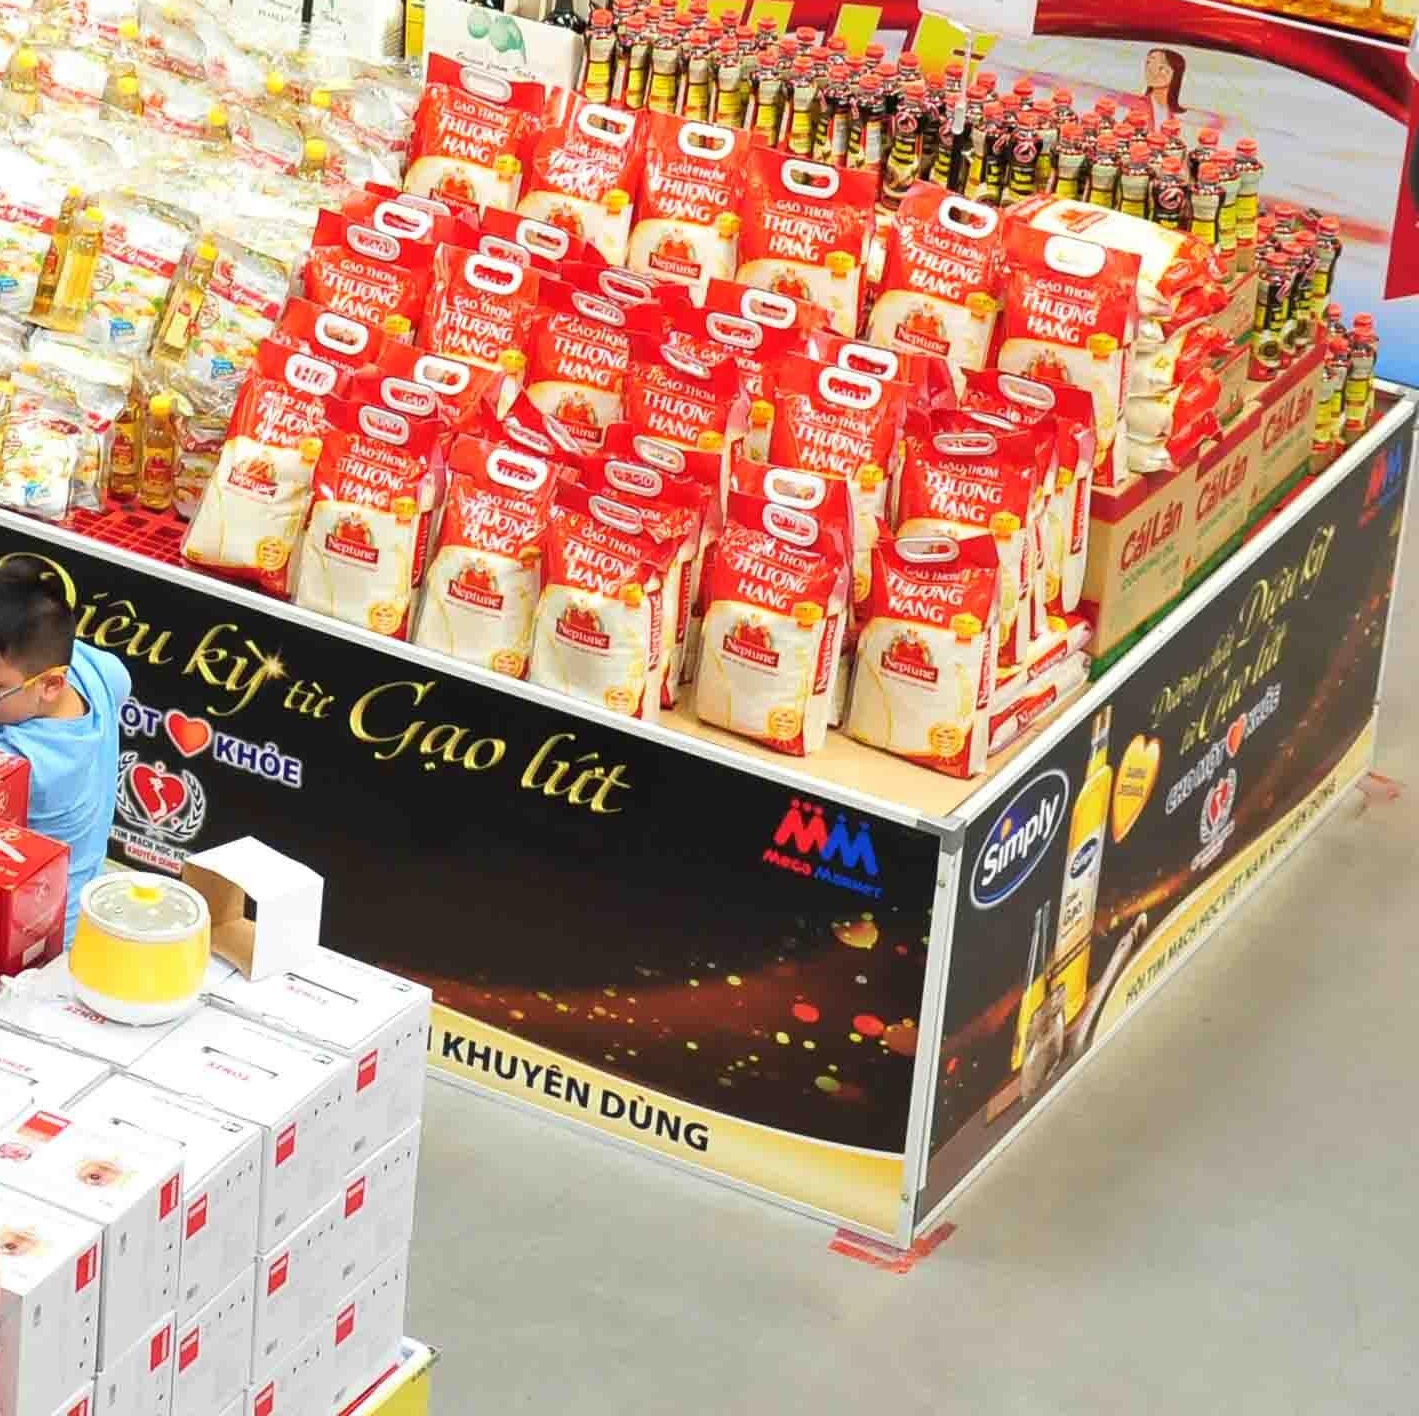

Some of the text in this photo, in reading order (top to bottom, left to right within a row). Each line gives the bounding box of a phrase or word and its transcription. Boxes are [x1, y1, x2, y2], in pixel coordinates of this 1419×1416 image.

[651, 255, 699, 277] Neptune
[897, 326, 948, 352] Neptune
[326, 535, 378, 560] Neptune
[556, 622, 609, 649] Neptune
[725, 639, 778, 667] Neptune
[882, 654, 938, 683] Neptune
[119, 696, 302, 786] ỘT KHỎE
[351, 681, 504, 774] Gạo
[981, 791, 1059, 887] Simply
[440, 1032, 711, 1153] KHUYÊN DÙNG
